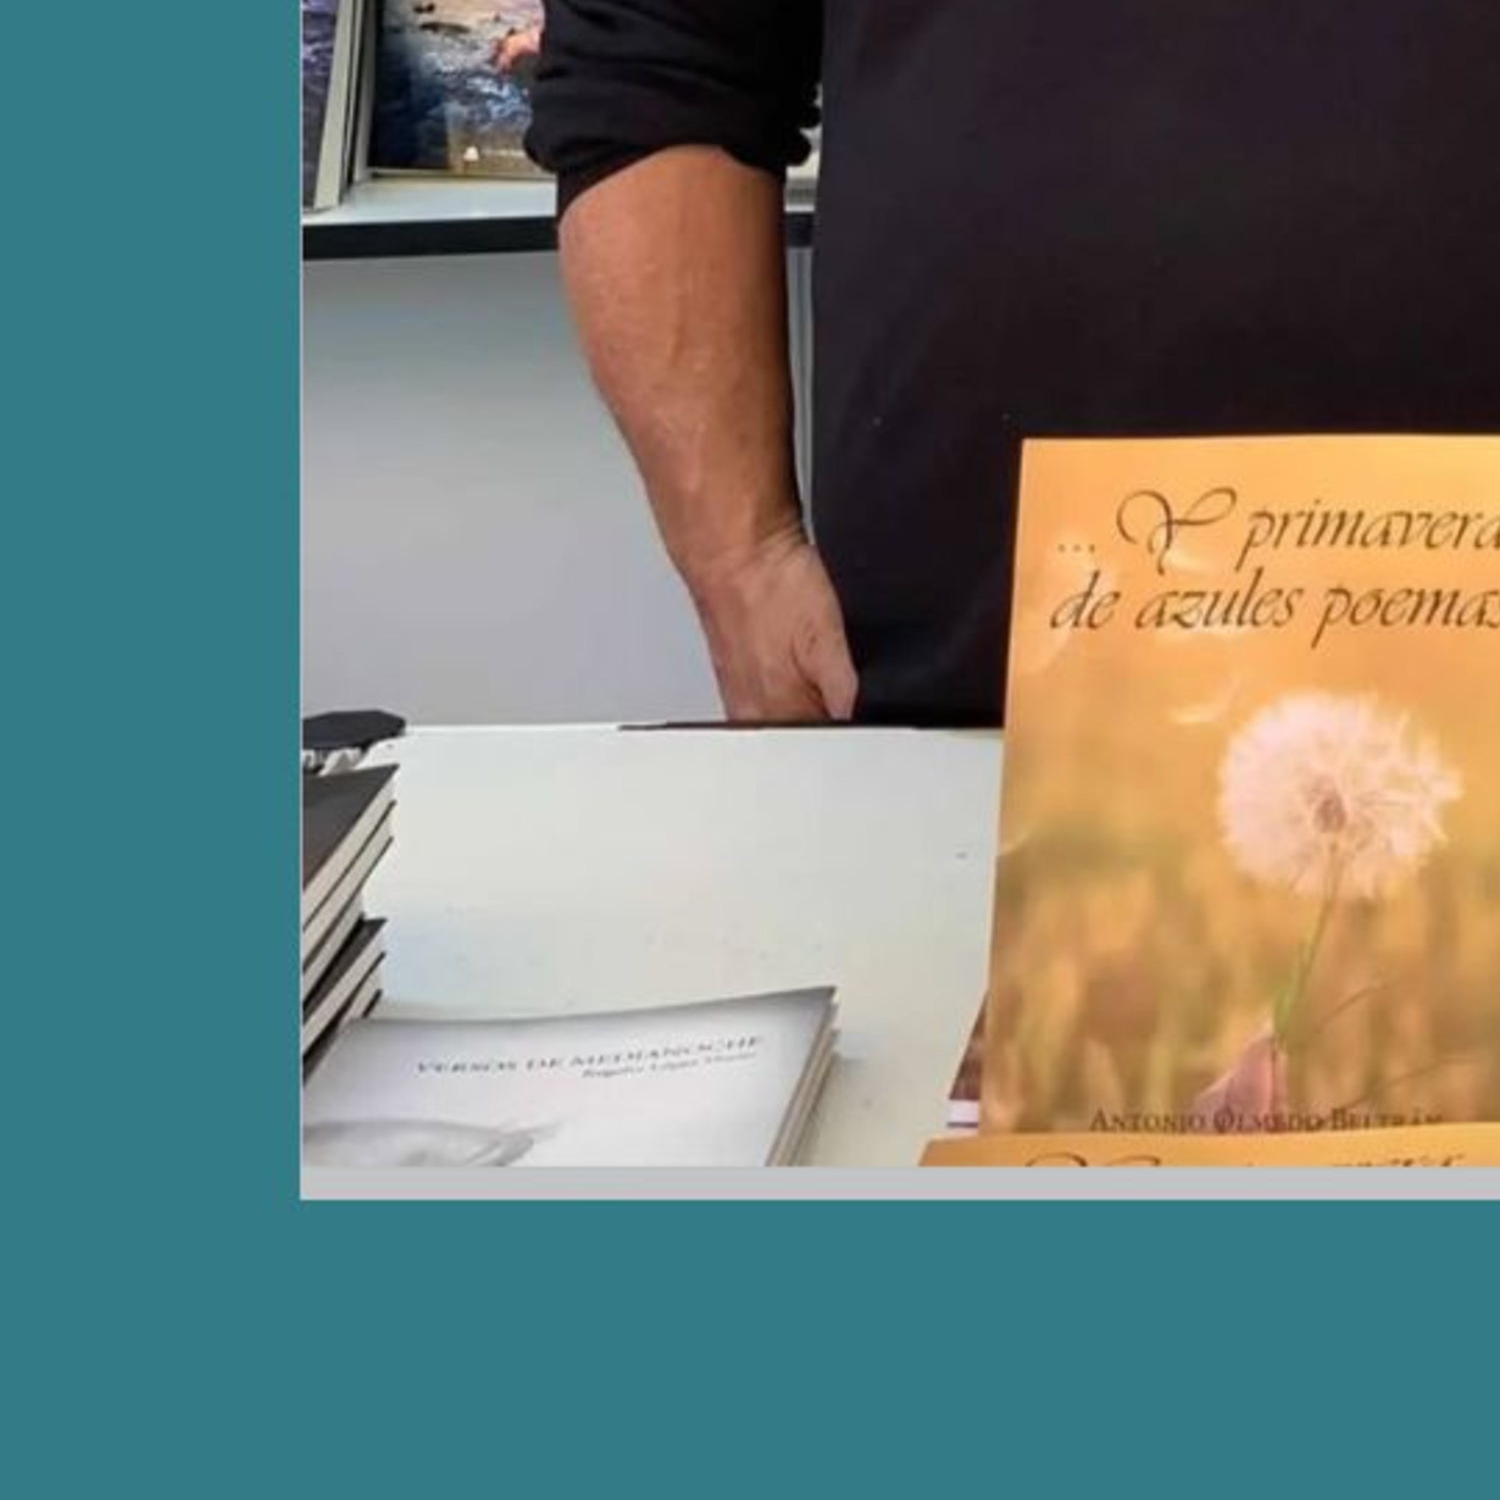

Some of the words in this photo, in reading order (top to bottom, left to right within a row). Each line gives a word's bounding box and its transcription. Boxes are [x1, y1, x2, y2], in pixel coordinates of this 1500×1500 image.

[1049, 570, 1121, 630] de
[1134, 567, 1306, 629] azules
[1088, 1108, 1205, 1134] ANTONIO
